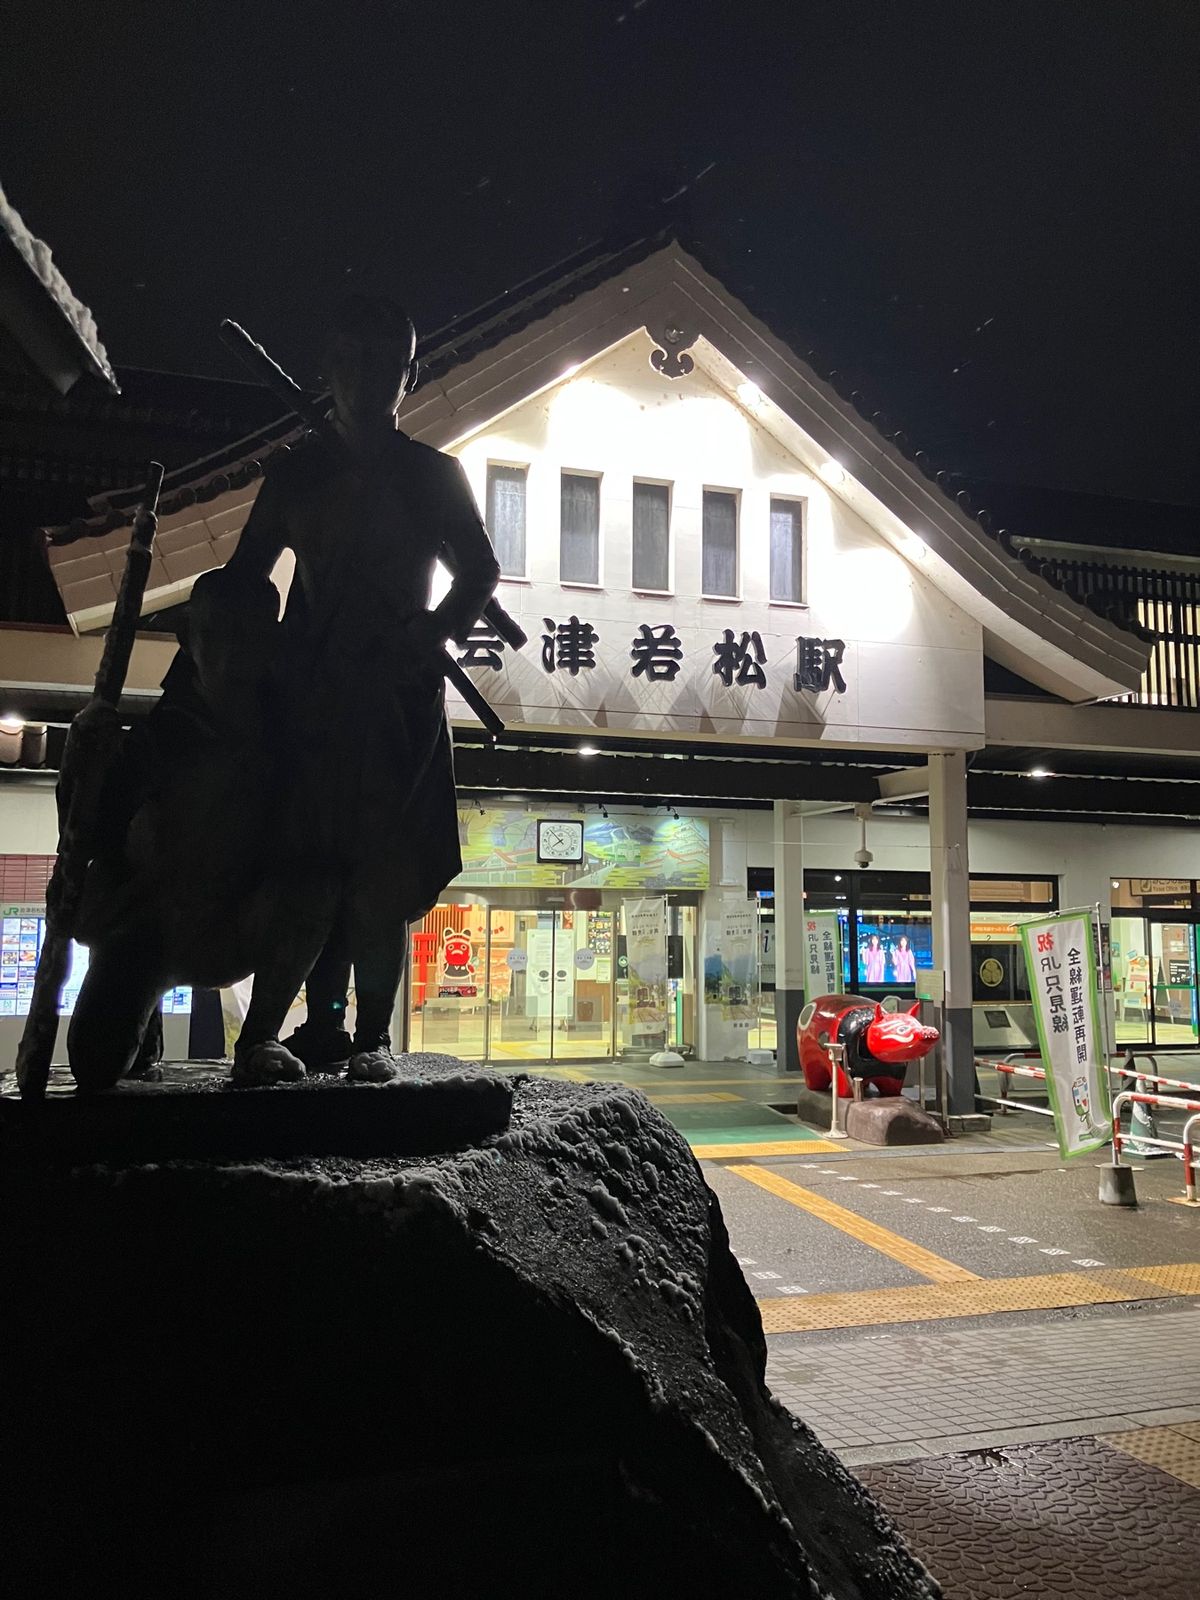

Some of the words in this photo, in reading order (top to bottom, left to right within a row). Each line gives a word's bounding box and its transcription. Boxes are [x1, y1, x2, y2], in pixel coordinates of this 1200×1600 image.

[456, 615, 847, 695] 会津若松駅
